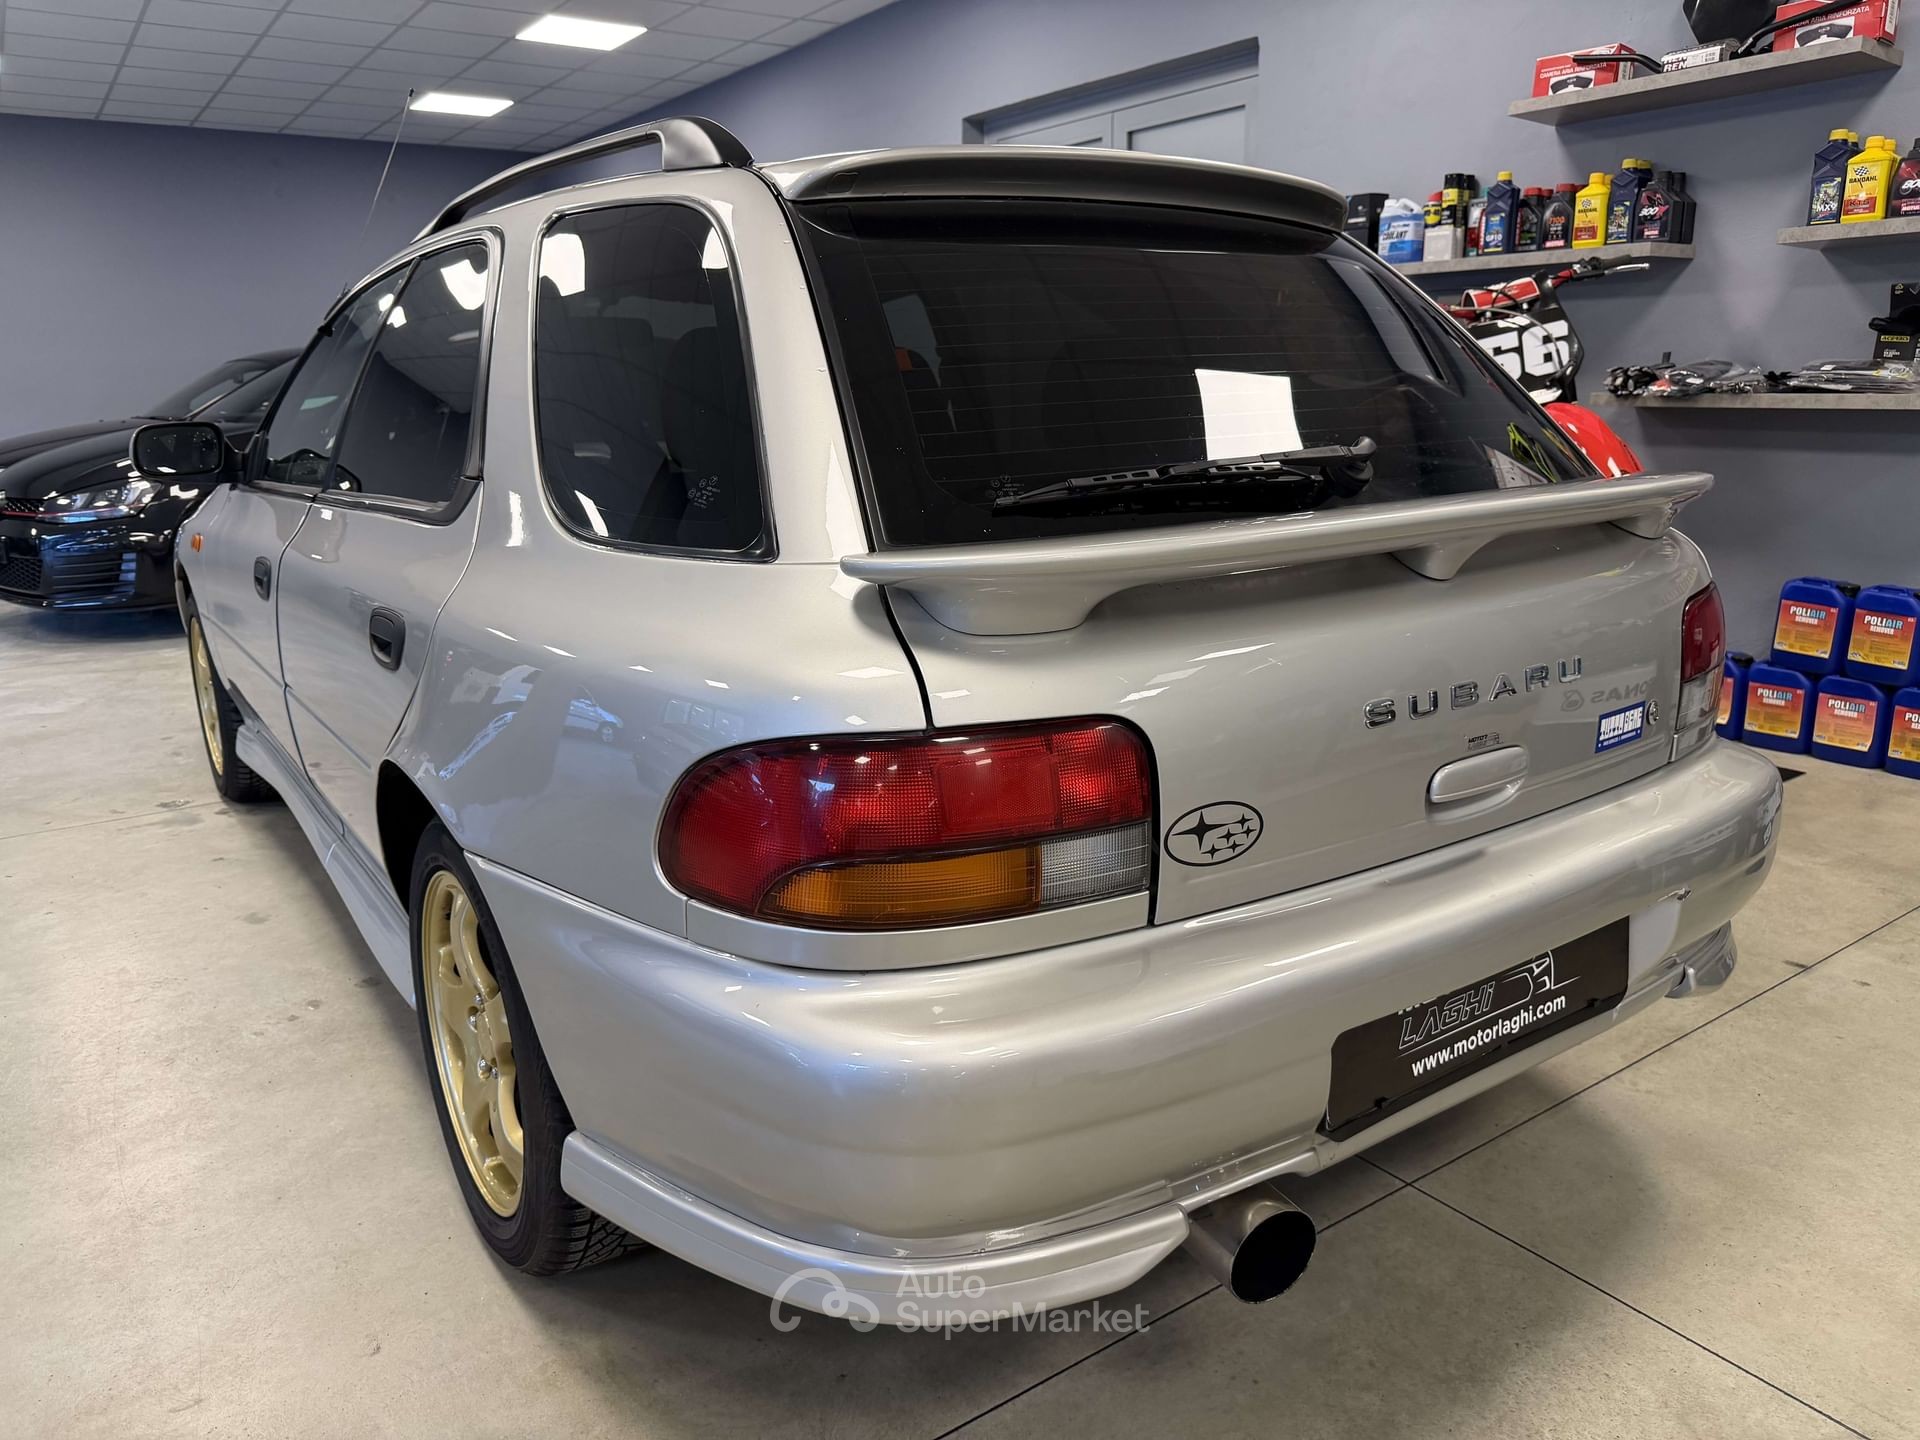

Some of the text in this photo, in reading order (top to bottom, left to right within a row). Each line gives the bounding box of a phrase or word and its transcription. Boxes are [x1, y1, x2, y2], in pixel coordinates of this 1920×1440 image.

[1827, 5, 1870, 20] RINFORZATA
[1539, 70, 1561, 79] CAMERA
[1561, 66, 1574, 75] ARIA
[1382, 230, 1409, 241] COOLANT
[1789, 605, 1827, 620] POLIAIR
[1863, 615, 1904, 630] POLIAIR
[1363, 654, 1583, 730] SUBARU
[1757, 688, 1793, 701] POLIAIR
[1827, 699, 1866, 713] POLIAIR
[1904, 712, 1920, 723] PO
[1411, 994, 1566, 1077] www.motorlaghi.com
